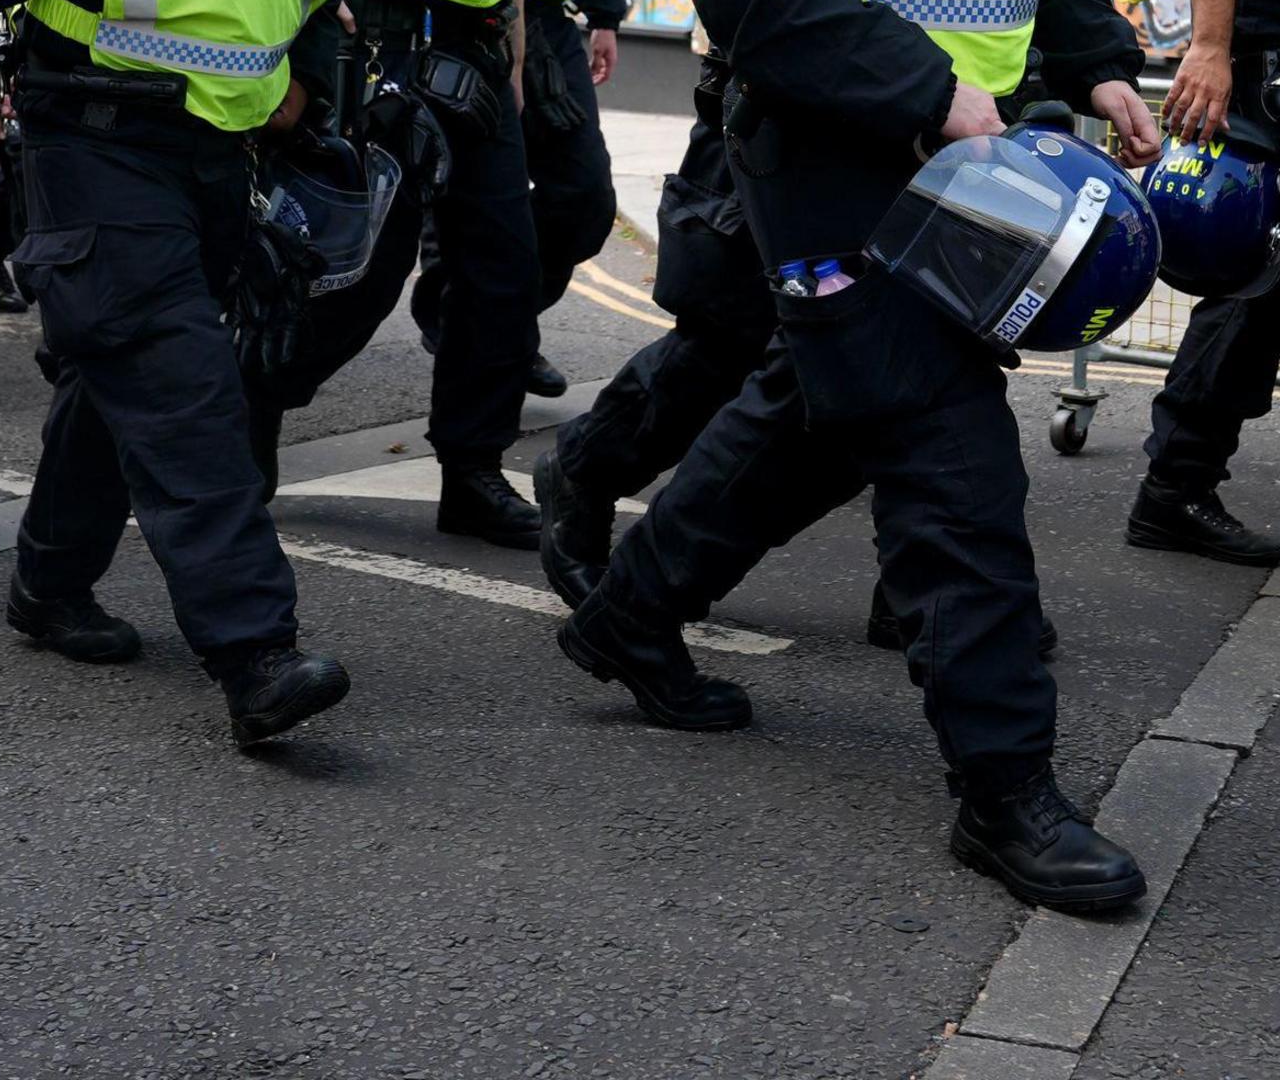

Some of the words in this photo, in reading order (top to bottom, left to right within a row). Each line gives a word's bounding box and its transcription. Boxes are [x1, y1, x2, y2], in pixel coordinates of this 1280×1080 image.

[1166, 156, 1204, 177] MP
[1154, 179, 1206, 199] 4058
[994, 286, 1046, 344] POLICE
[1079, 306, 1115, 345] MP
